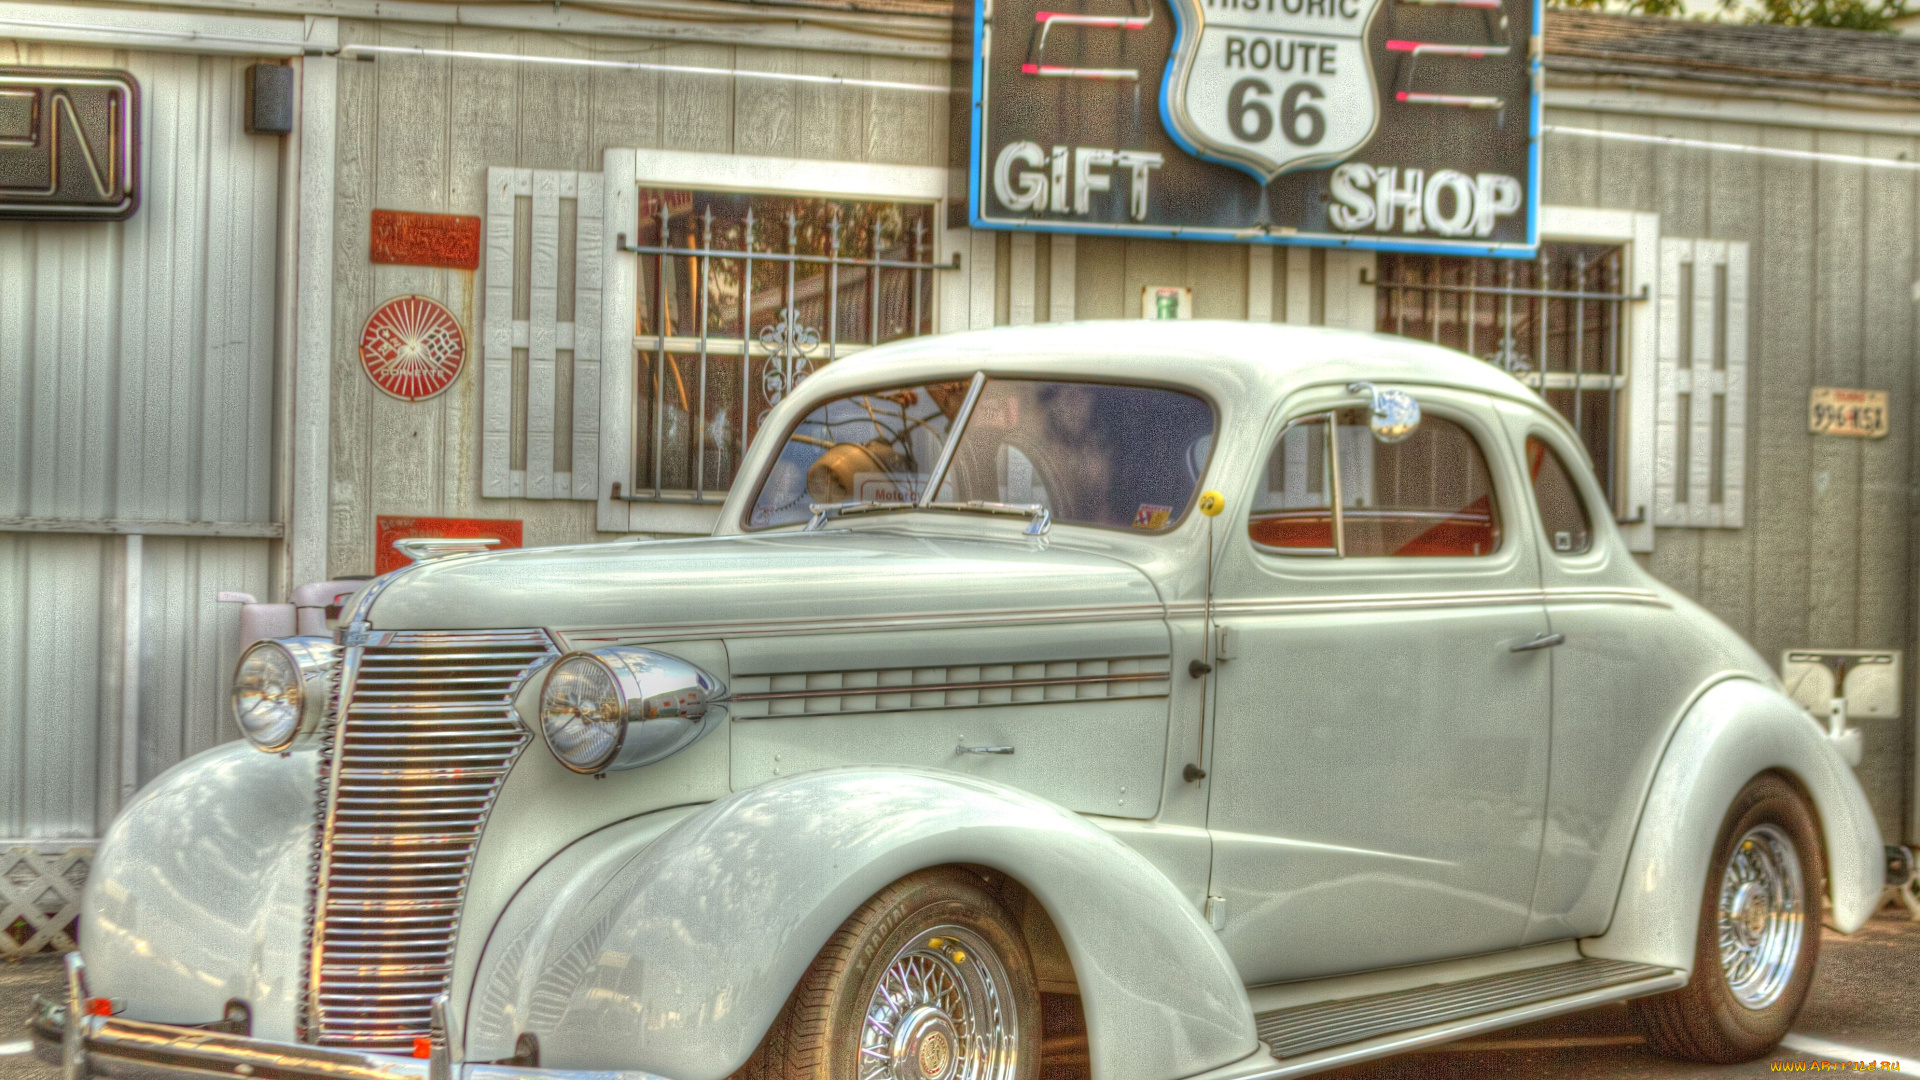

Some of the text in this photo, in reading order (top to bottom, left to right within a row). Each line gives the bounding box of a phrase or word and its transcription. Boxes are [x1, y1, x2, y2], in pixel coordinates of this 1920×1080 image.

[1225, 36, 1337, 75] ROUTE
[1226, 76, 1326, 147] 66
[994, 140, 1522, 237] GIFT SHOP
[380, 368, 445, 378] CORVETTE
